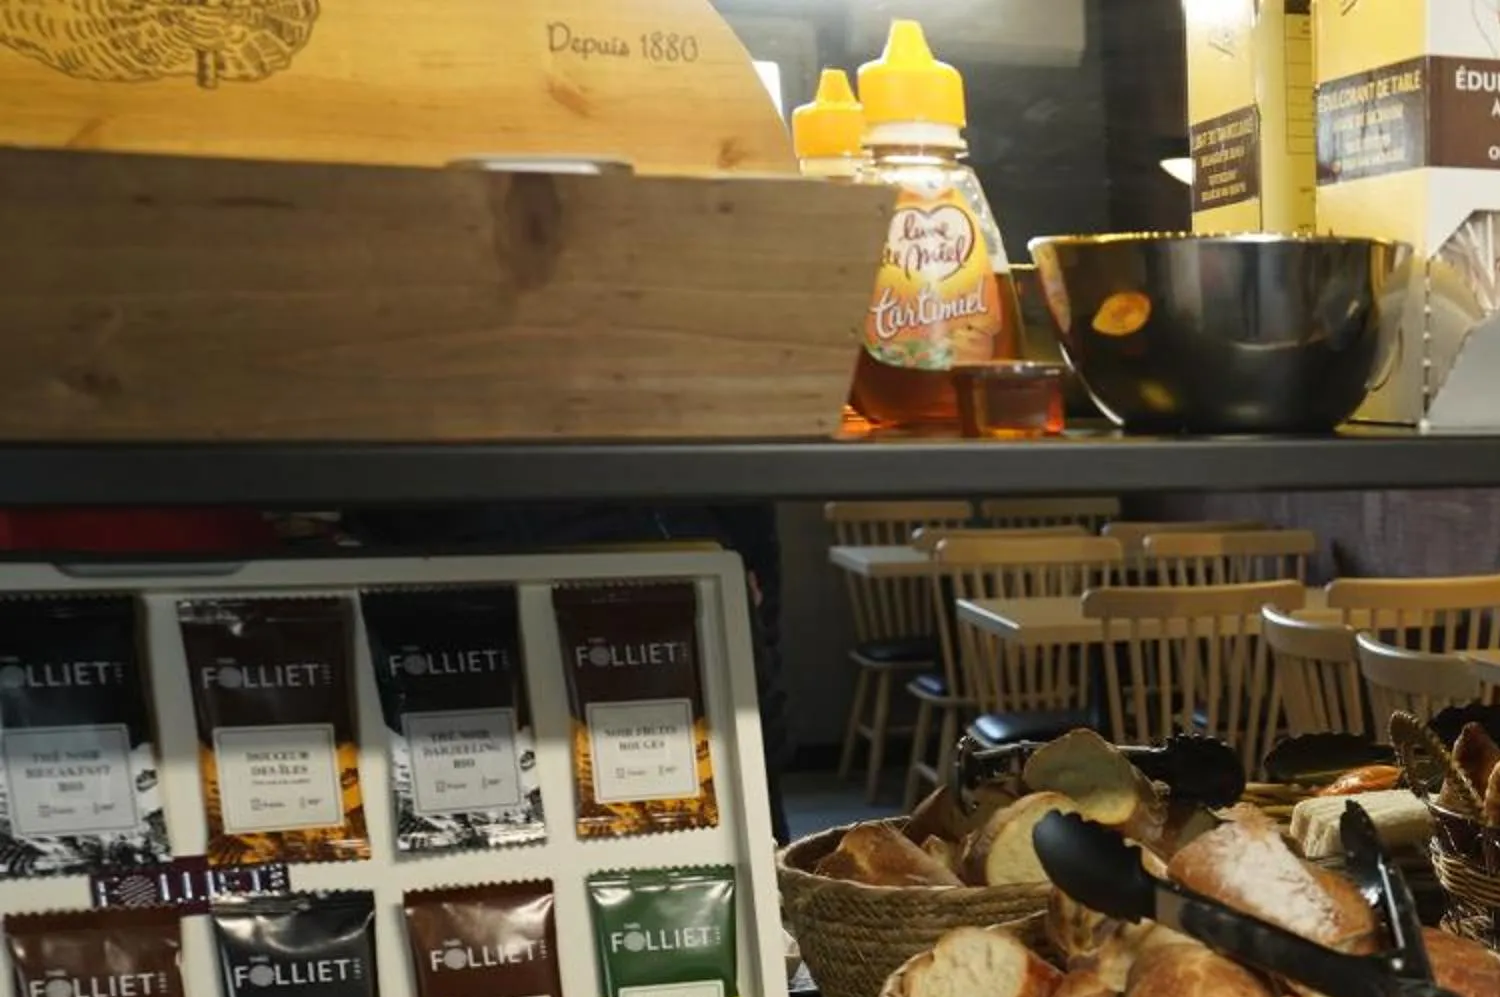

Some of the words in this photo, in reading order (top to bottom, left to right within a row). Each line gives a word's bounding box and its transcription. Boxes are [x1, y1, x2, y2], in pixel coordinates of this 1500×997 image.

[546, 21, 630, 61] Depuis
[640, 31, 699, 63] 1880
[0, 661, 110, 690] OLLIET
[234, 959, 350, 988] FOLLIET
